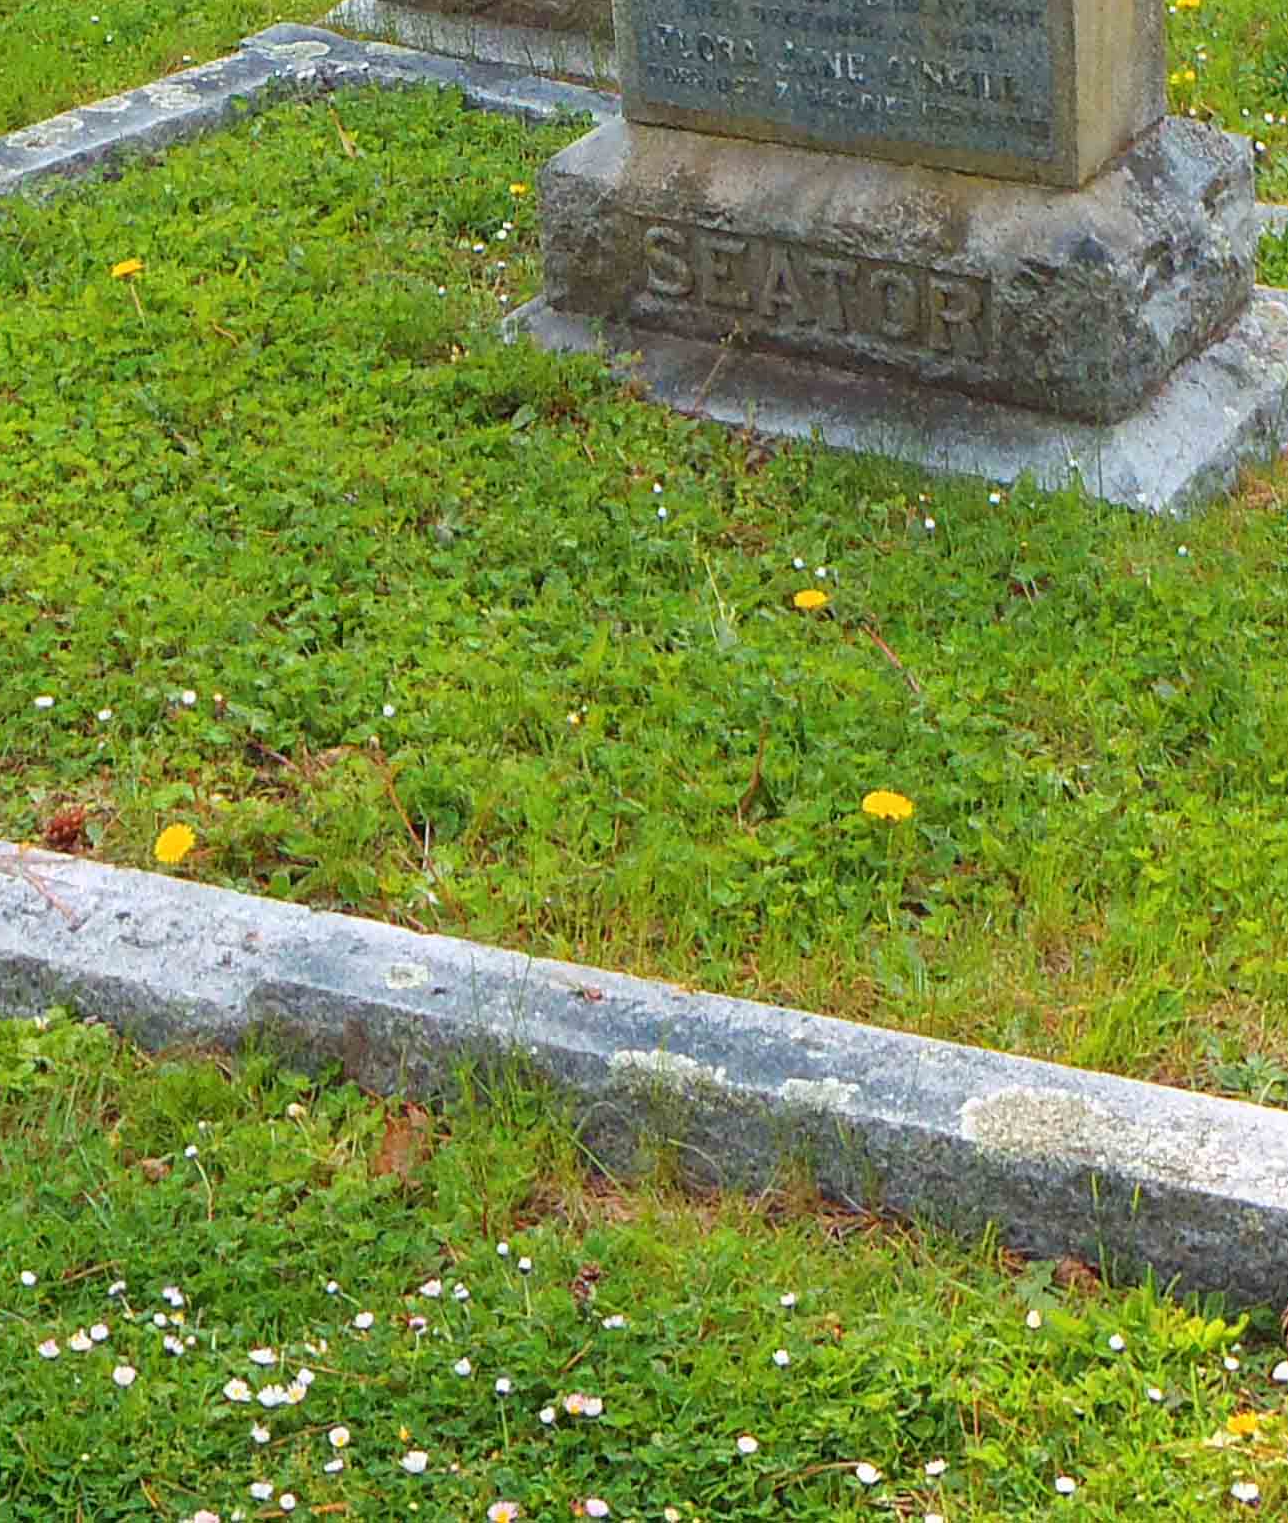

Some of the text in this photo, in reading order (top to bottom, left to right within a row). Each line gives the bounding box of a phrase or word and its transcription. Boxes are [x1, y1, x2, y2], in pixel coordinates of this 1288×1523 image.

[655, 22, 757, 64] FLORA
[775, 38, 866, 81] JANE
[645, 225, 992, 359] SEATOR
